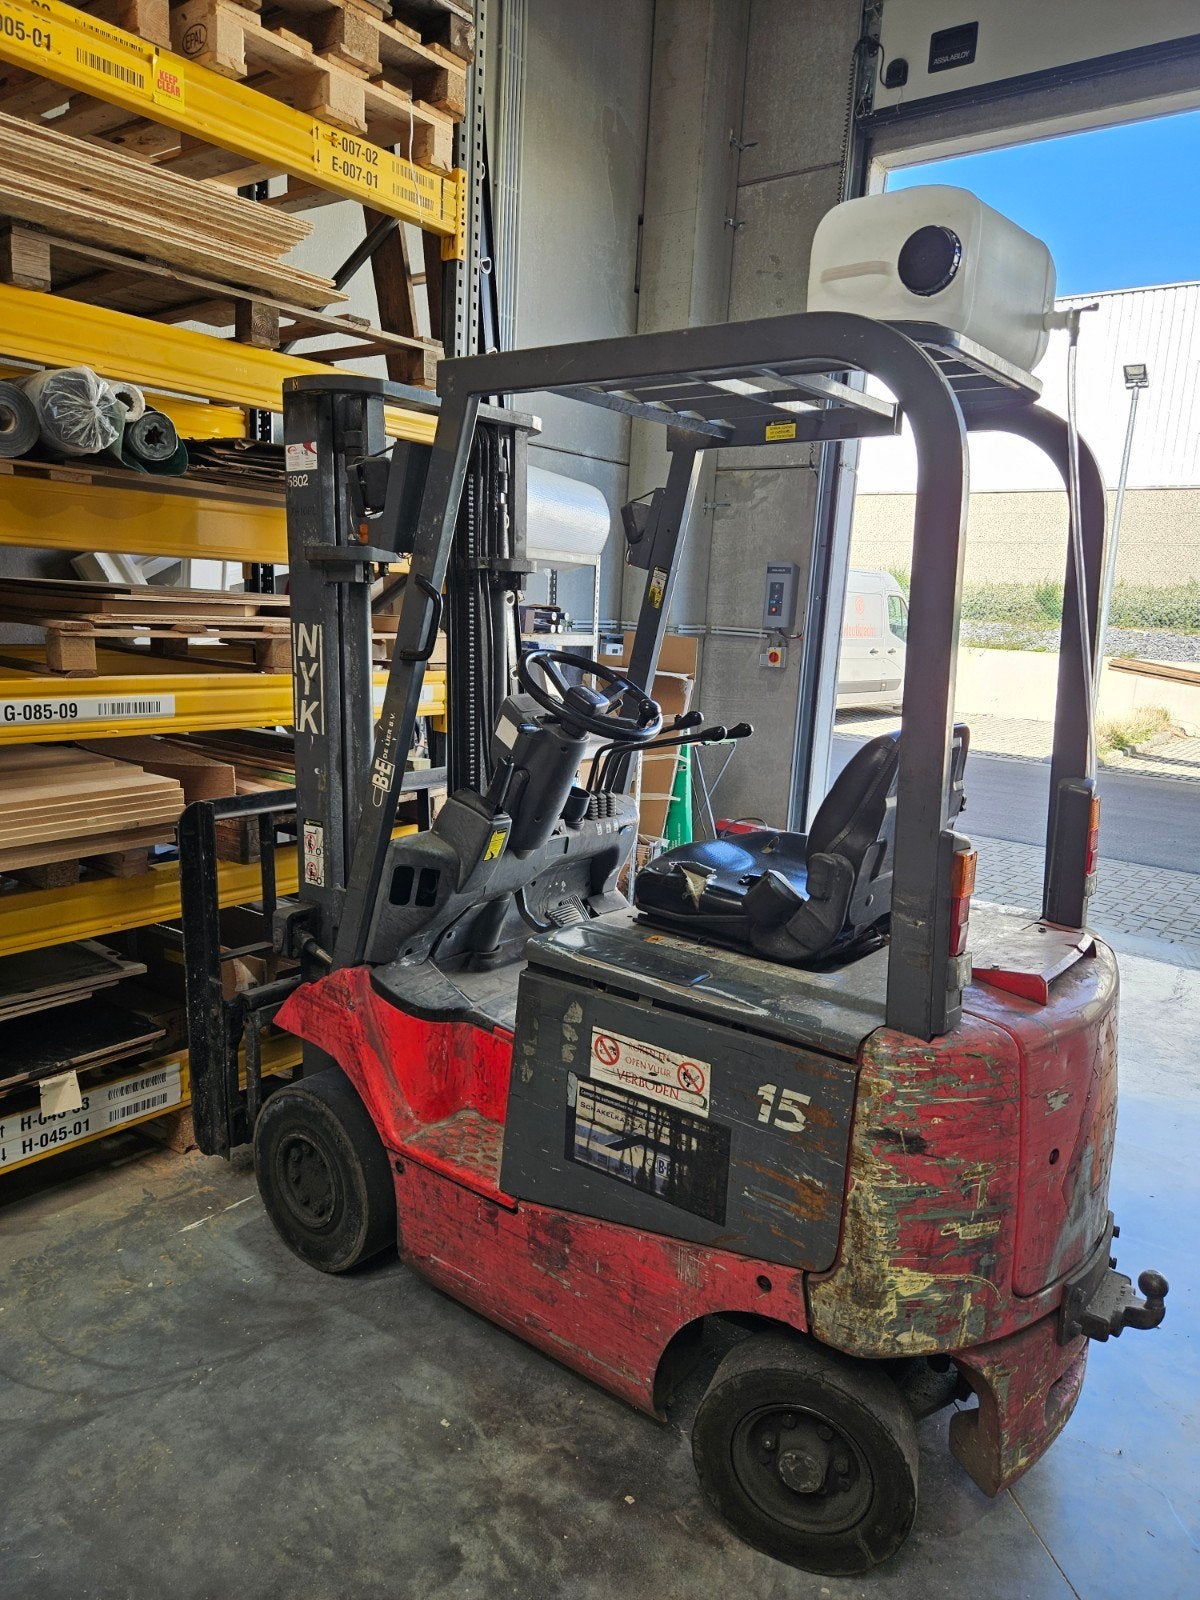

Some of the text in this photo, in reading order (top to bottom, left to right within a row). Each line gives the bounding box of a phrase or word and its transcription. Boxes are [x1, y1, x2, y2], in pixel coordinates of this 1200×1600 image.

[185, 28, 203, 50] EPAL
[157, 78, 181, 98] CLEAR
[159, 69, 178, 85] KEEP
[330, 131, 379, 166] E-007-02
[331, 155, 379, 189] E-007-01
[297, 622, 321, 735] NYK
[4, 702, 78, 722] G-085-09
[616, 1068, 679, 1100] VERBODEN
[757, 1083, 811, 1132] 15
[22, 1118, 90, 1154] H-045-01
